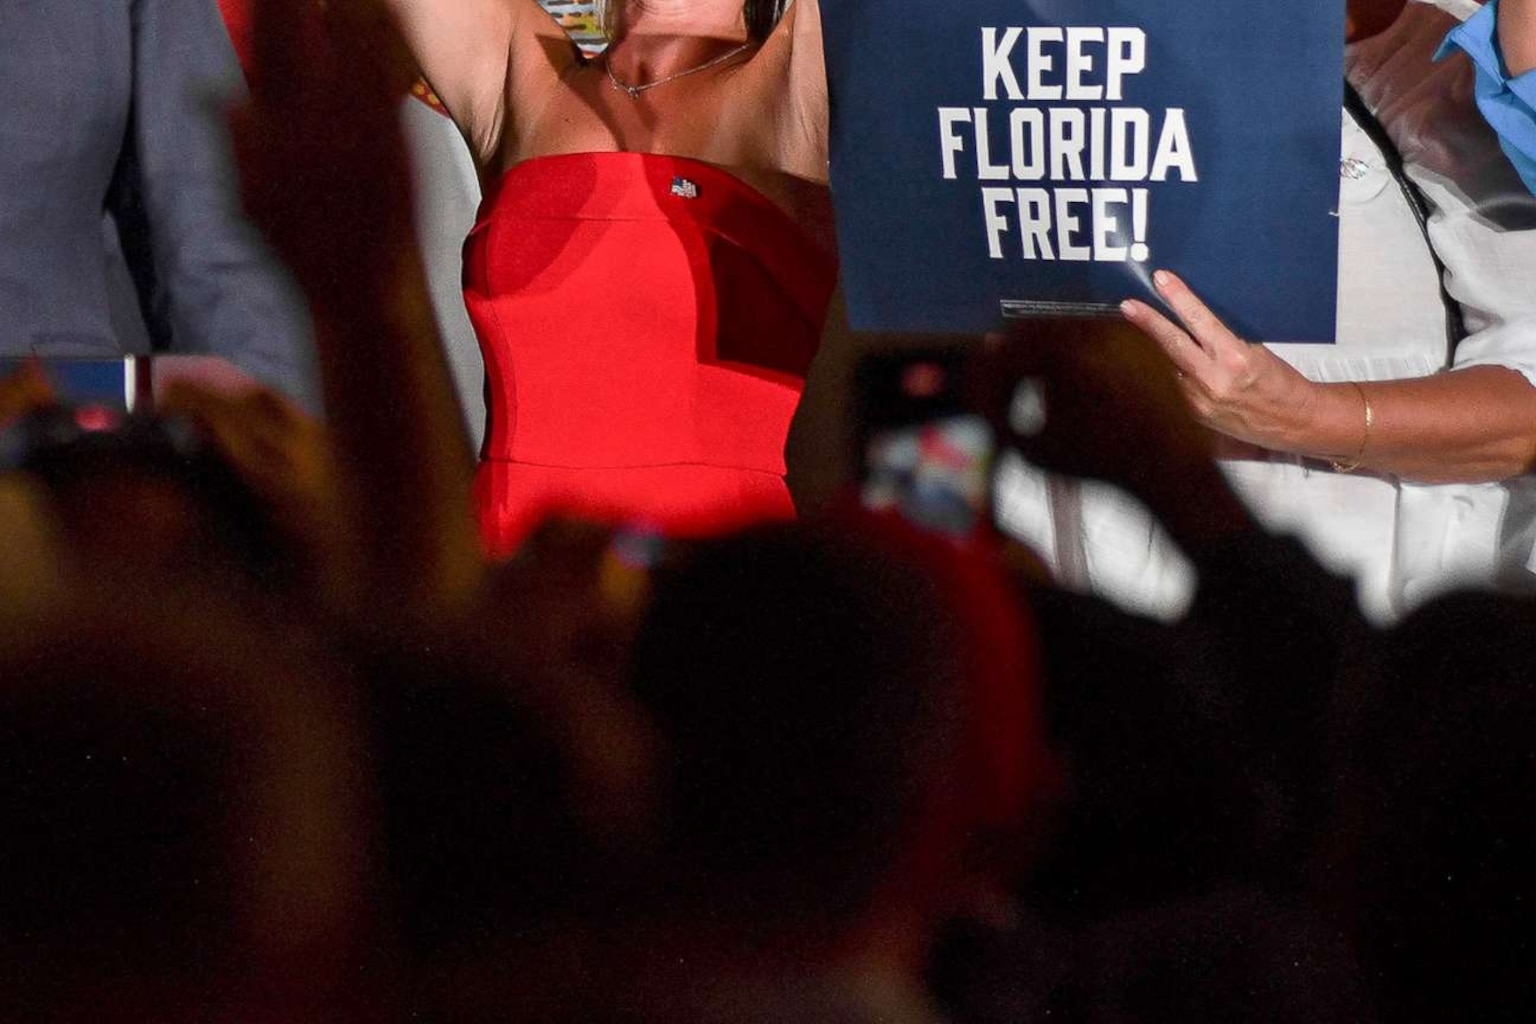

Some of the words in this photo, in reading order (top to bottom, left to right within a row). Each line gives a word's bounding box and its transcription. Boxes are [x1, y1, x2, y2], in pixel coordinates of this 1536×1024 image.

[981, 26, 1145, 100] KEEP
[937, 107, 1198, 182] FLORIDA
[981, 187, 1150, 262] FREE!
